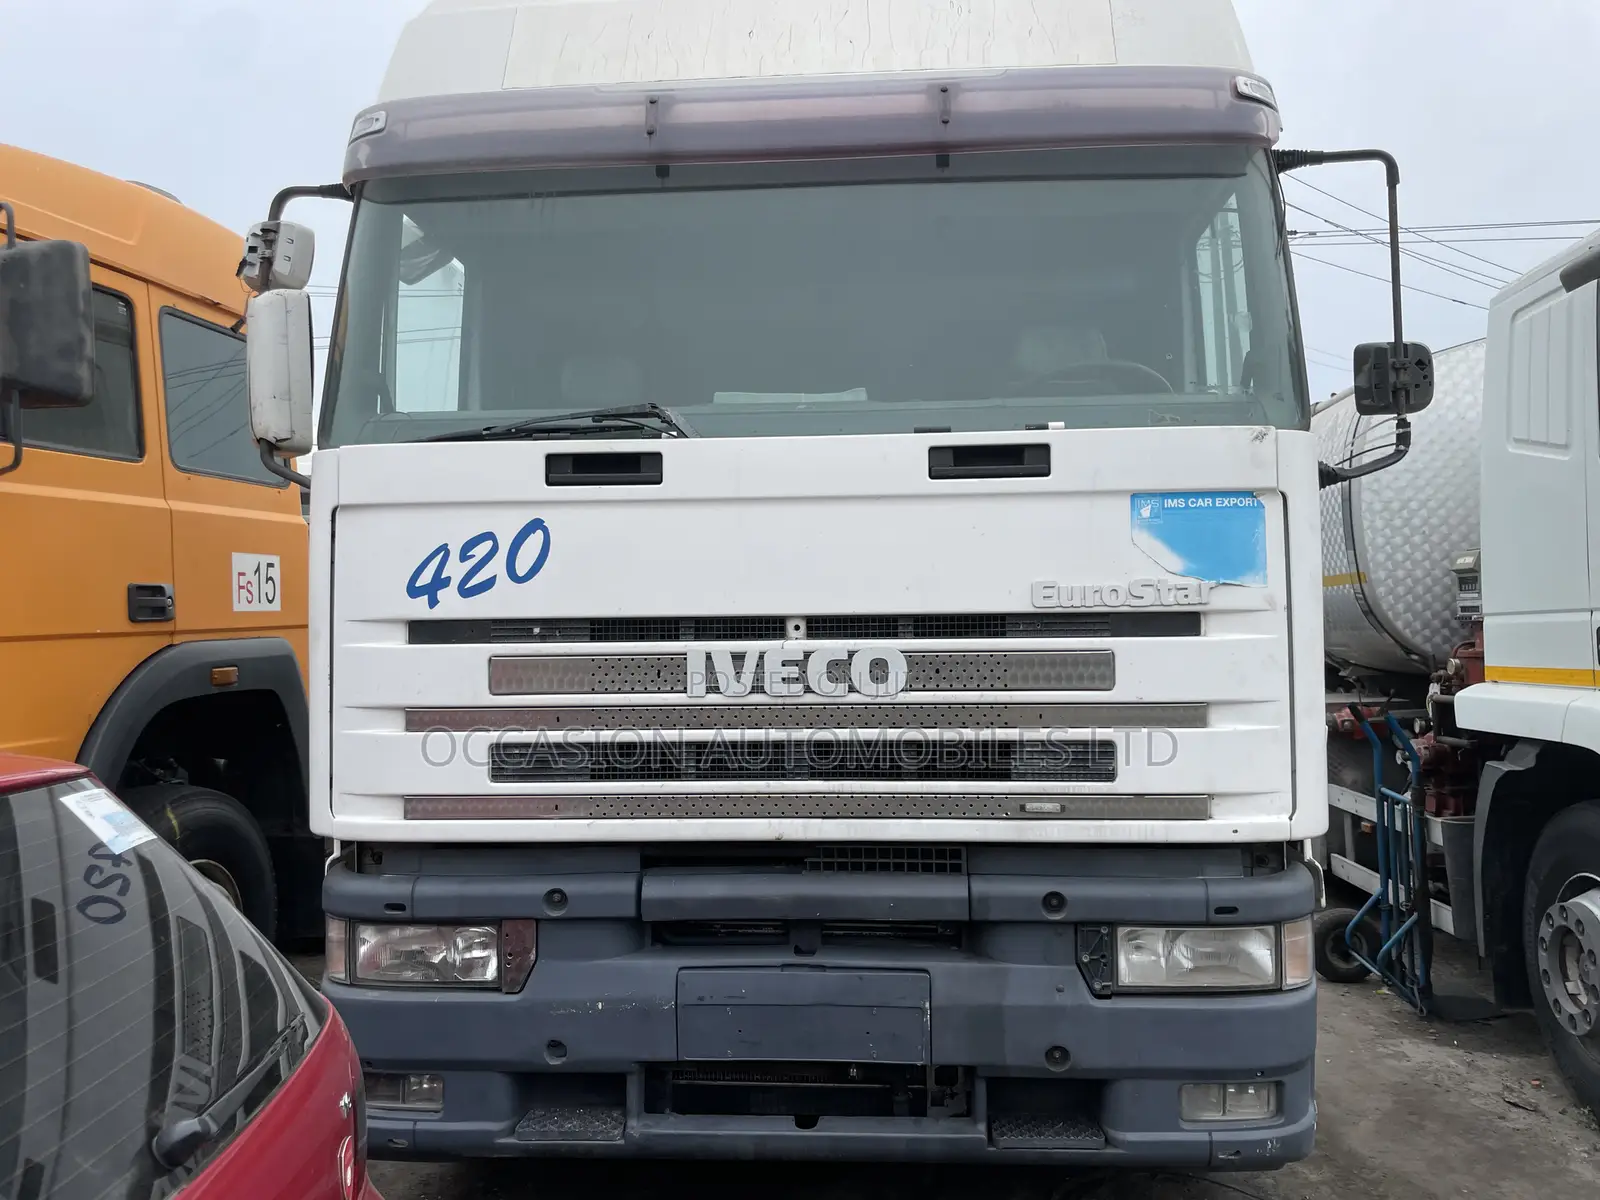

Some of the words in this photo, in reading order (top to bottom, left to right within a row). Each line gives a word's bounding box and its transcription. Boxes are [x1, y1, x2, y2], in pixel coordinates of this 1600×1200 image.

[1164, 498, 1186, 508] IMS
[1188, 498, 1213, 508] CAR
[1217, 497, 1258, 507] EXPORT
[405, 517, 551, 610] 420
[1031, 578, 1213, 609] EuroStar
[686, 648, 908, 697] IVECO
